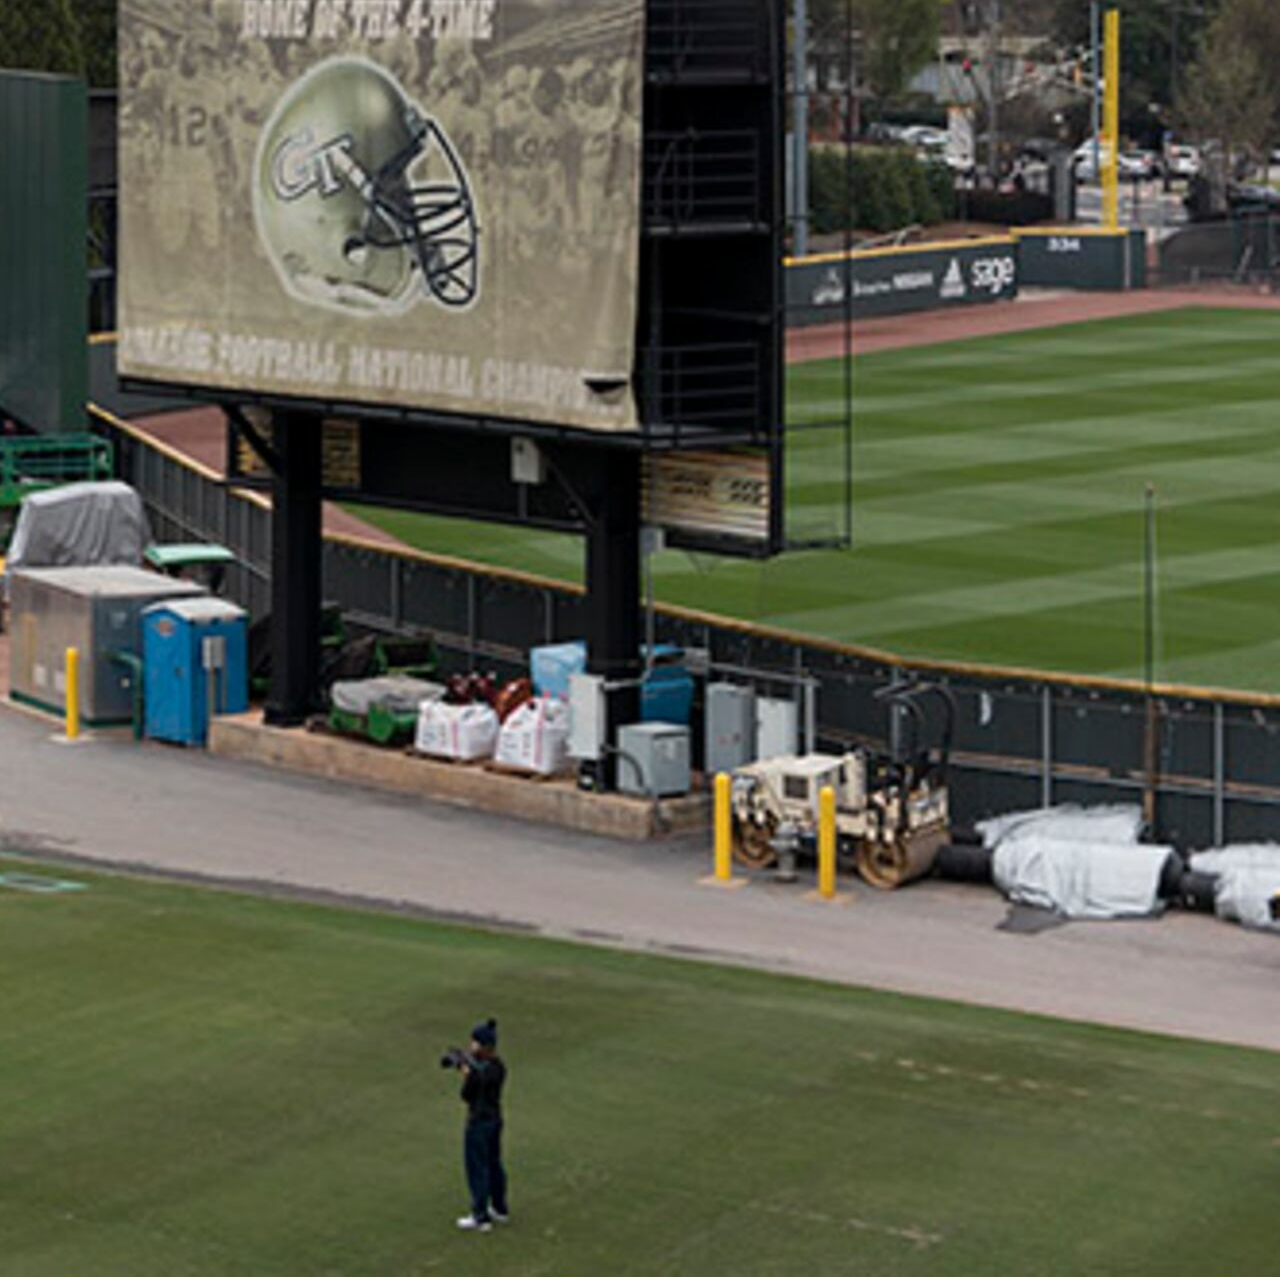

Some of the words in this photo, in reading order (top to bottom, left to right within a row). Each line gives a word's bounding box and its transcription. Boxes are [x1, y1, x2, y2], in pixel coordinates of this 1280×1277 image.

[971, 256, 1015, 294] sage
[219, 333, 342, 385] FOOTBALL
[348, 345, 474, 398] NATIONAL
[480, 357, 626, 416] CHAMPIO
